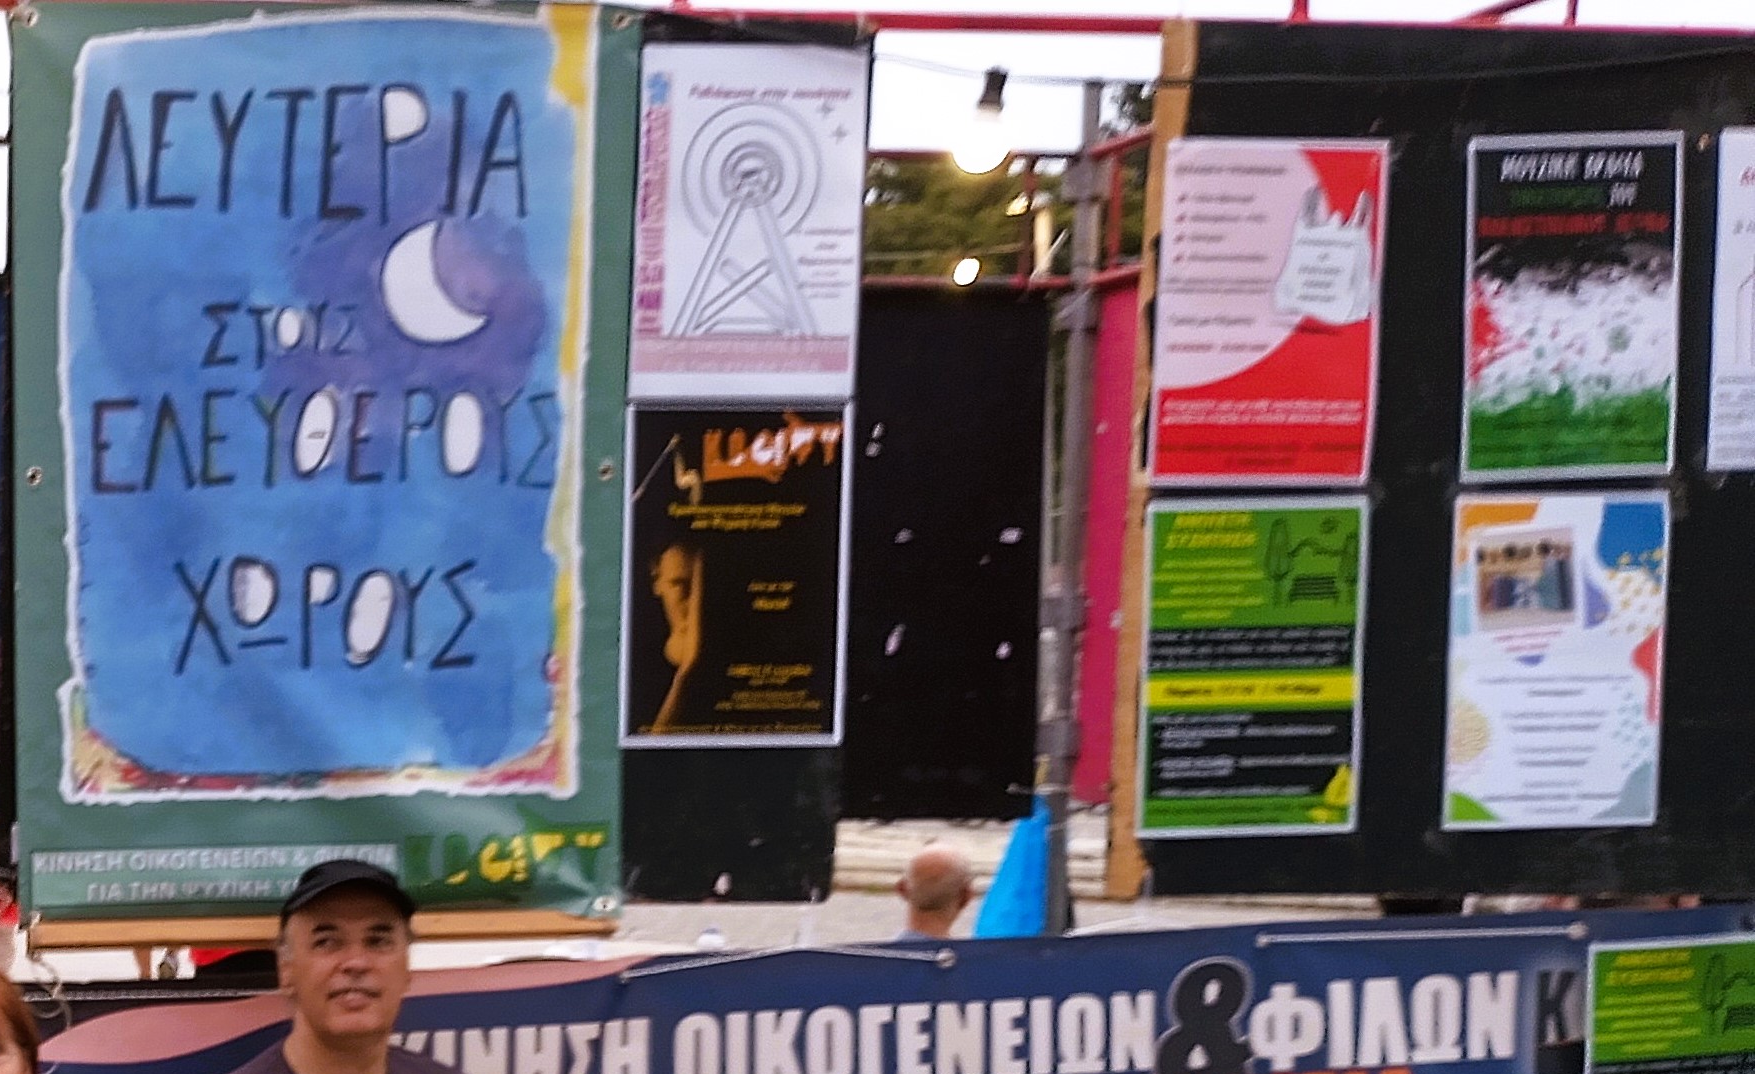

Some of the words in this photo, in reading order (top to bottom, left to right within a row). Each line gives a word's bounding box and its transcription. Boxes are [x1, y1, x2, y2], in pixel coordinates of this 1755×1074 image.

[82, 82, 528, 225] ΛΕΥΤΕΡΙΑ
[202, 301, 356, 371] ΣΤΟΥΣ
[91, 388, 559, 494] ΕΛΕΥΘΕΡΟΥΣ
[175, 556, 476, 674] ΧΩΡΟΥΣ
[1249, 970, 1522, 1071] ΦΙΛΩΝ
